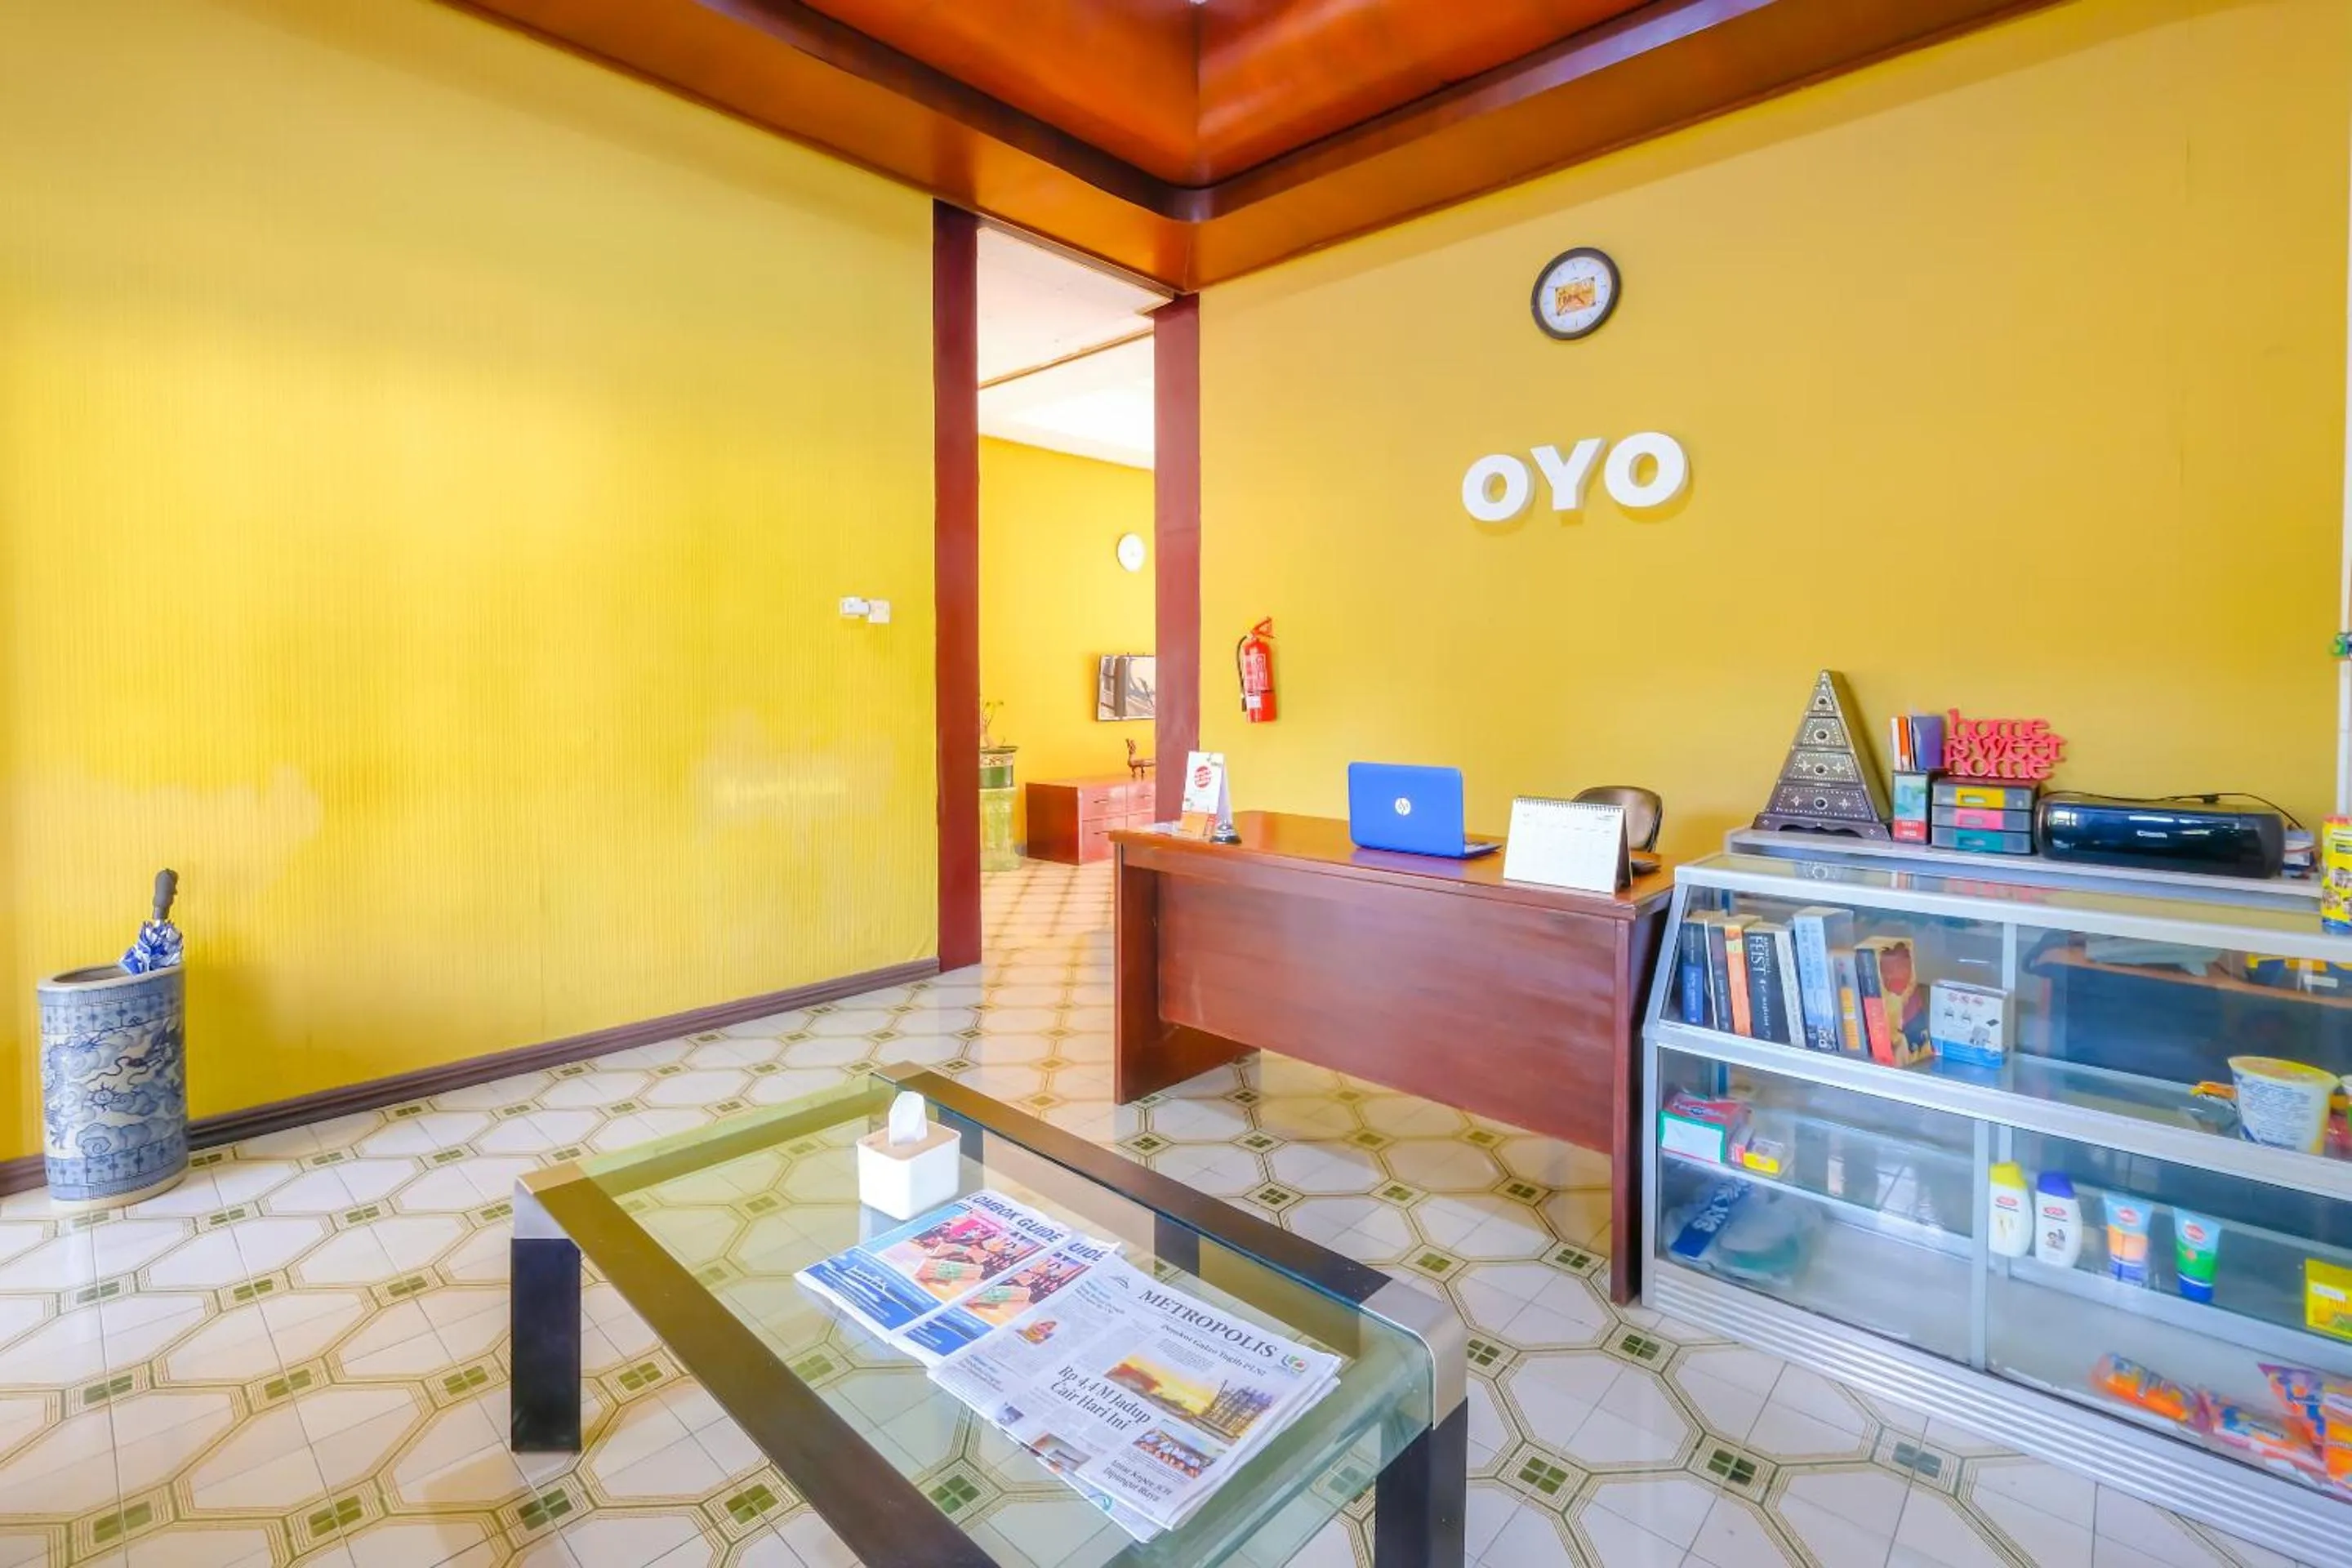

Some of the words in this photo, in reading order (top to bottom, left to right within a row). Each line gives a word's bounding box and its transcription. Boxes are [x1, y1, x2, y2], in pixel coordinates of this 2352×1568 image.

[1462, 431, 1689, 522] OYO
[1947, 708, 2049, 738] home
[1946, 733, 2067, 763] sweet
[1749, 935, 1766, 975] FEIST
[1017, 1218, 1064, 1242] GUIDE
[1068, 1242, 1107, 1262] UIDE
[1138, 1290, 1277, 1357] METROPOLIS
[1051, 1381, 1080, 1402] Cair
[1076, 1395, 1111, 1418] Hari
[1107, 1411, 1132, 1431] Ini
[1058, 1365, 1079, 1382] Rp
[1098, 1386, 1115, 1400] M
[1109, 1393, 1152, 1424] Jadup
